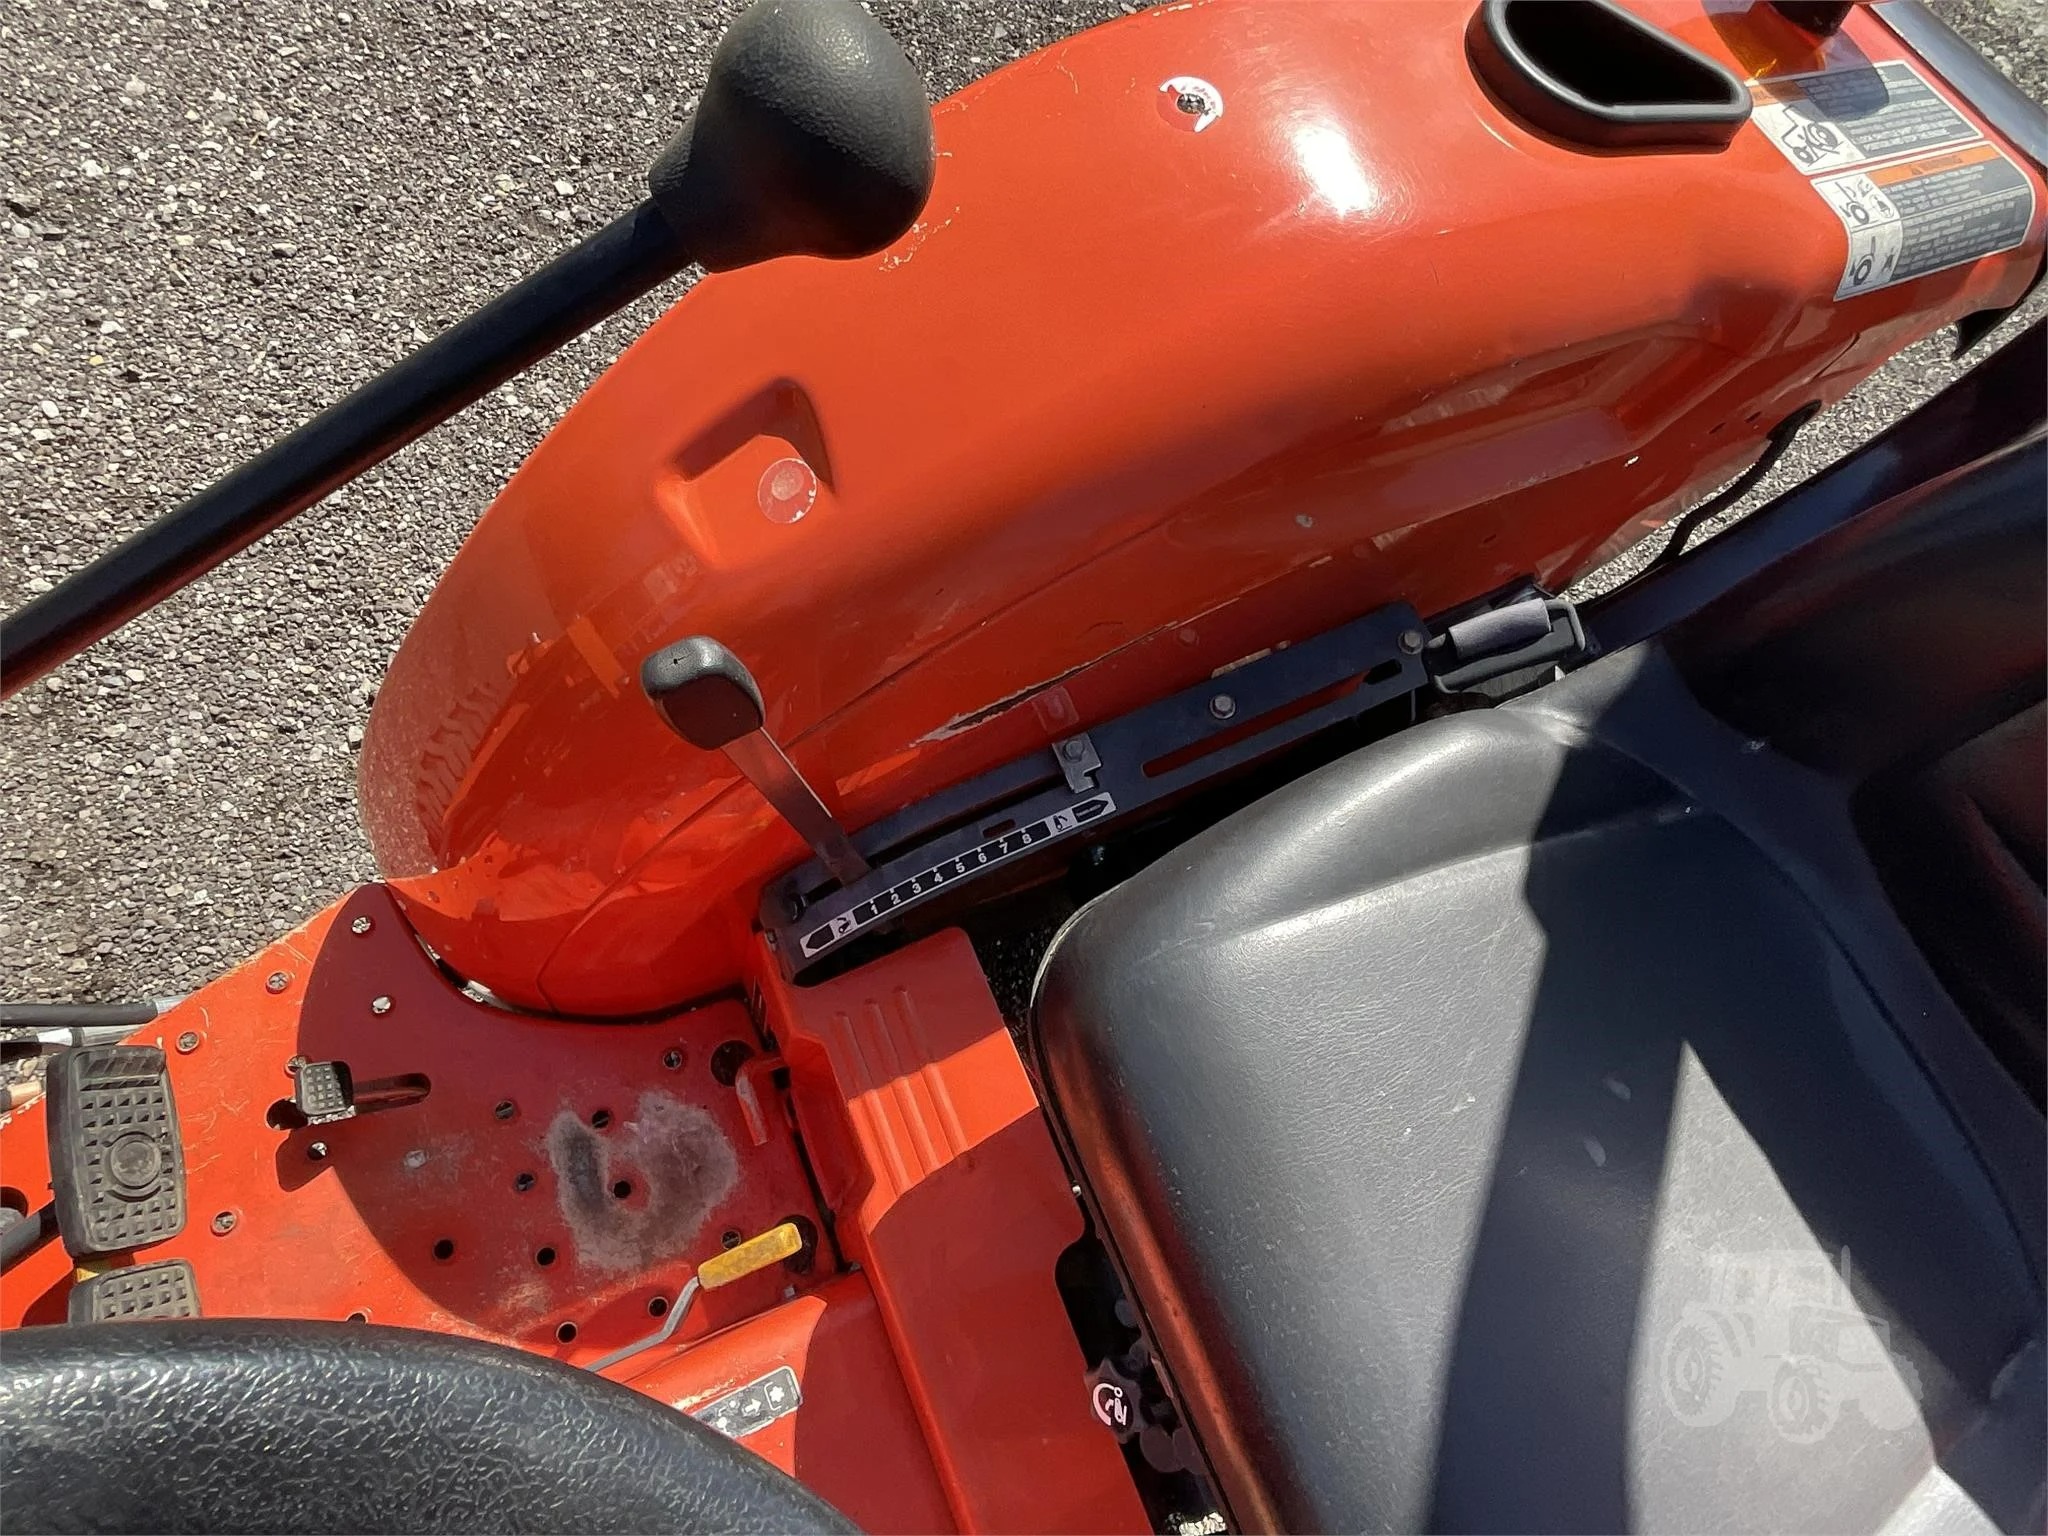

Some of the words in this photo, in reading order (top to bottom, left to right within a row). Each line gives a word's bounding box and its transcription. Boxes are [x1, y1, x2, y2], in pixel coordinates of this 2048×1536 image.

[870, 904, 878, 915] 1
[891, 893, 901, 905] 2
[912, 883, 922, 894] 3
[934, 872, 944, 883] 4
[955, 862, 965, 873] 5
[977, 852, 987, 863] 6
[999, 843, 1008, 854] 7
[1021, 833, 1032, 844] 8
